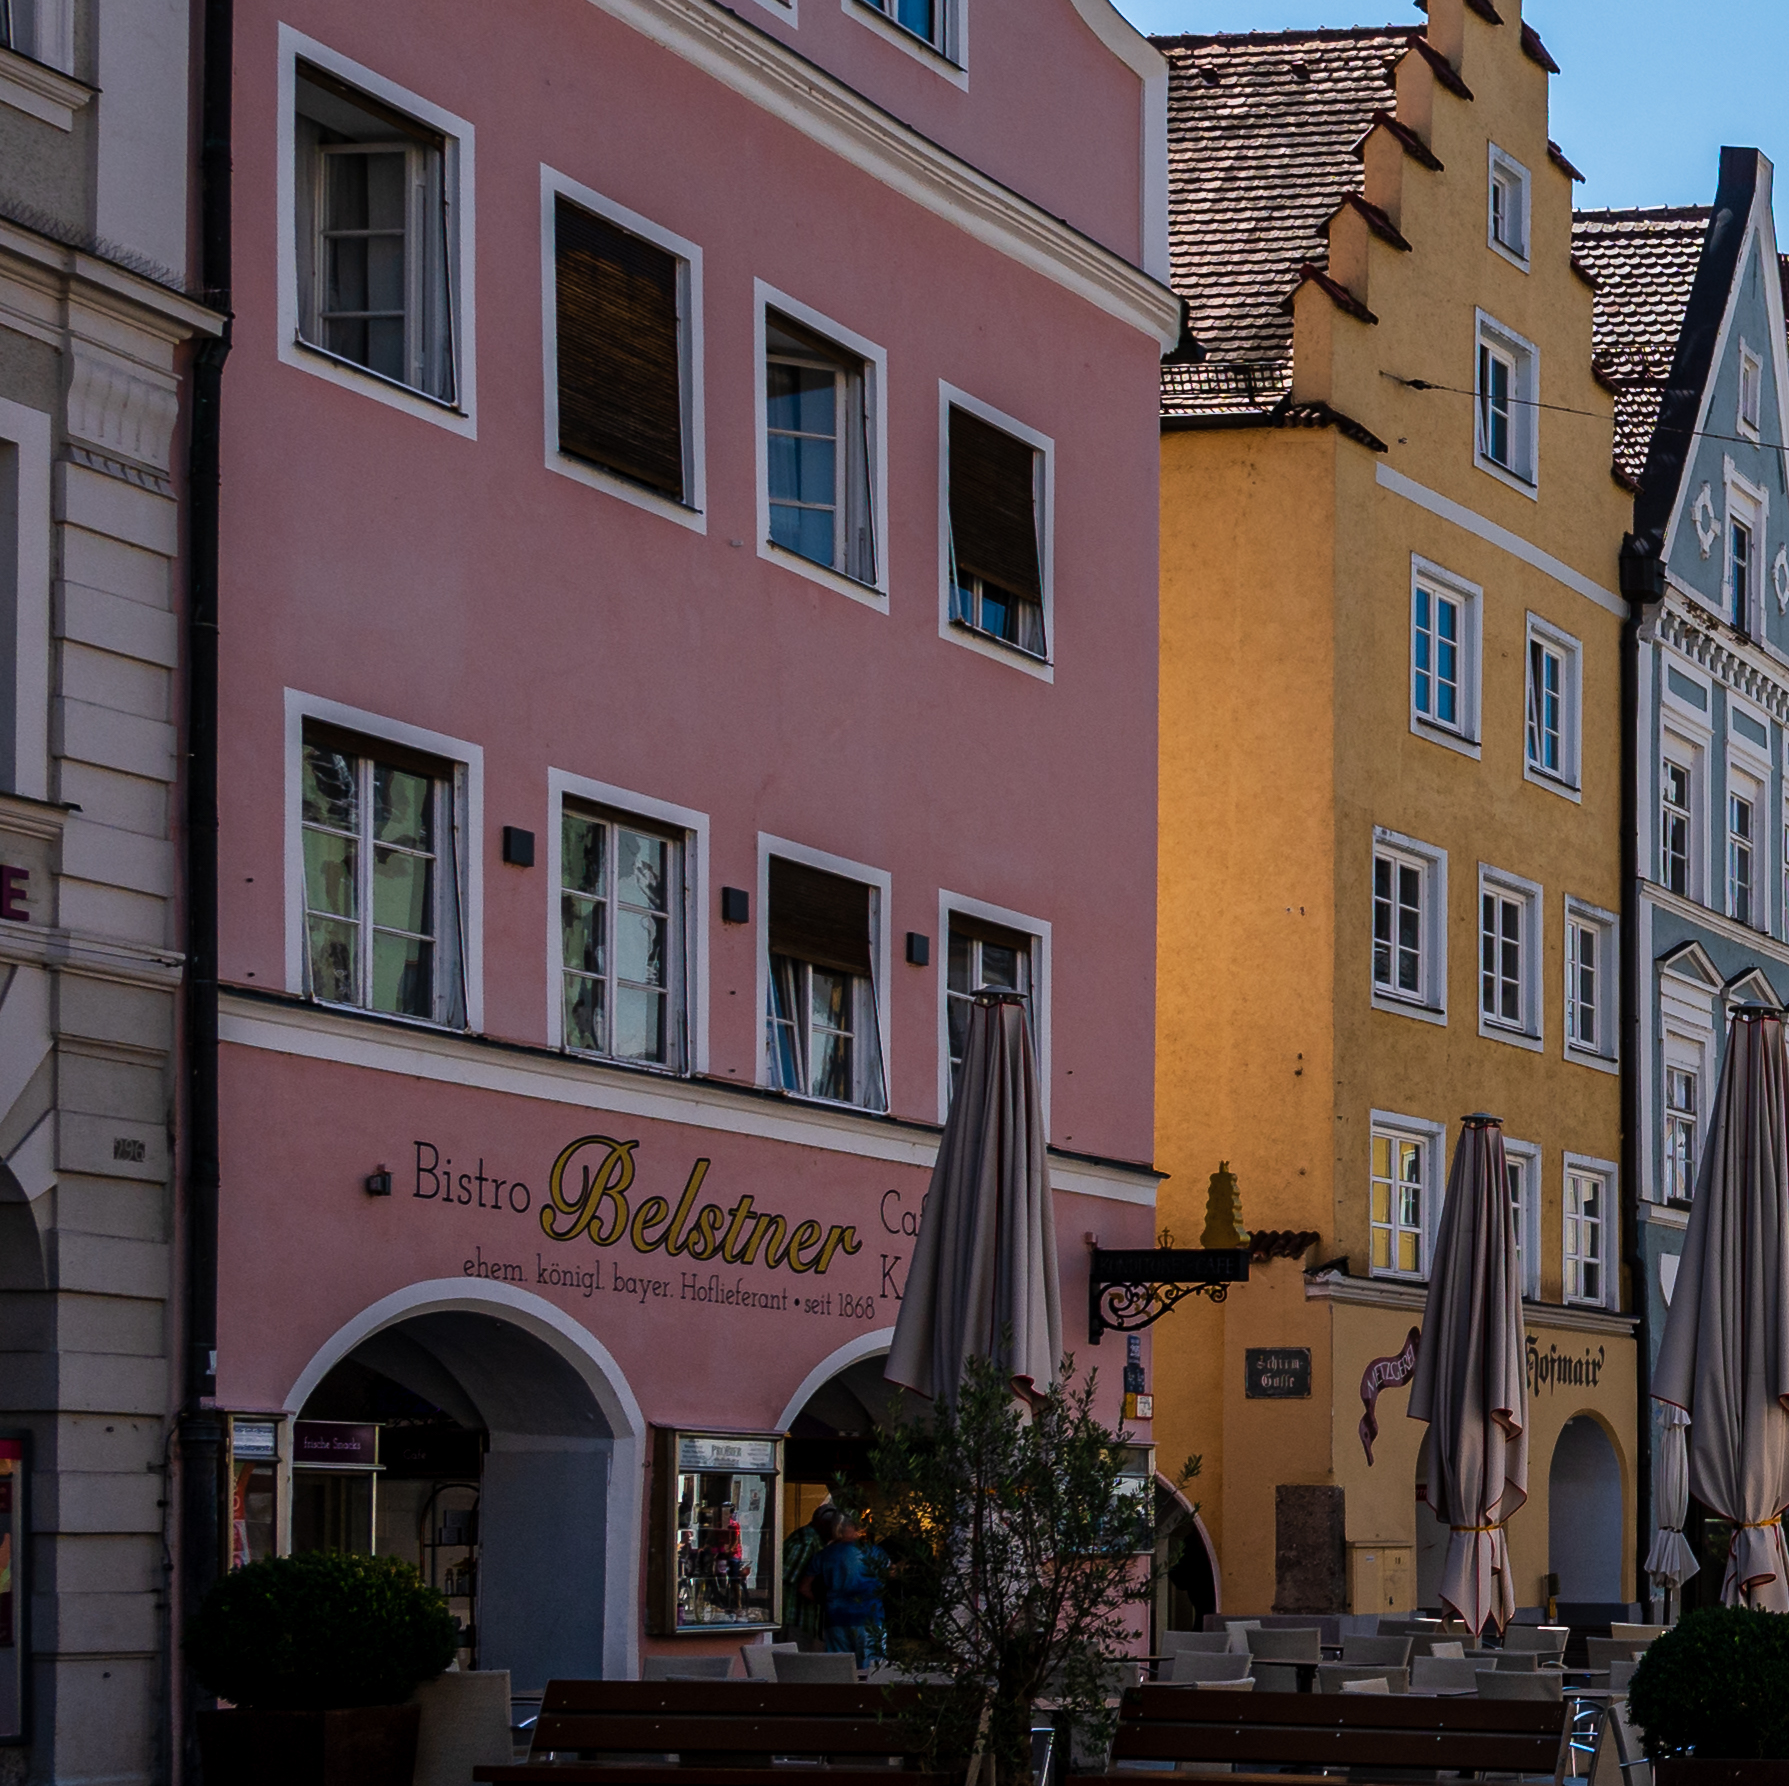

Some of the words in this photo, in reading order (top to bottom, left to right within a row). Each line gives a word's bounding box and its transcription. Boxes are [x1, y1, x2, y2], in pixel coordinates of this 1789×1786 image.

[413, 1140, 531, 1214] Bistro
[539, 1134, 863, 1275] Belstner
[463, 1246, 528, 1282] ehem.
[536, 1253, 606, 1298] königl.
[613, 1262, 675, 1304] bayer.
[680, 1271, 789, 1312] Hoflieferant
[804, 1295, 832, 1316] seit
[838, 1292, 876, 1320] 1868
[1366, 1342, 1416, 1398] METZGEREI
[303, 1436, 330, 1450] frische
[333, 1437, 361, 1450] Snacks
